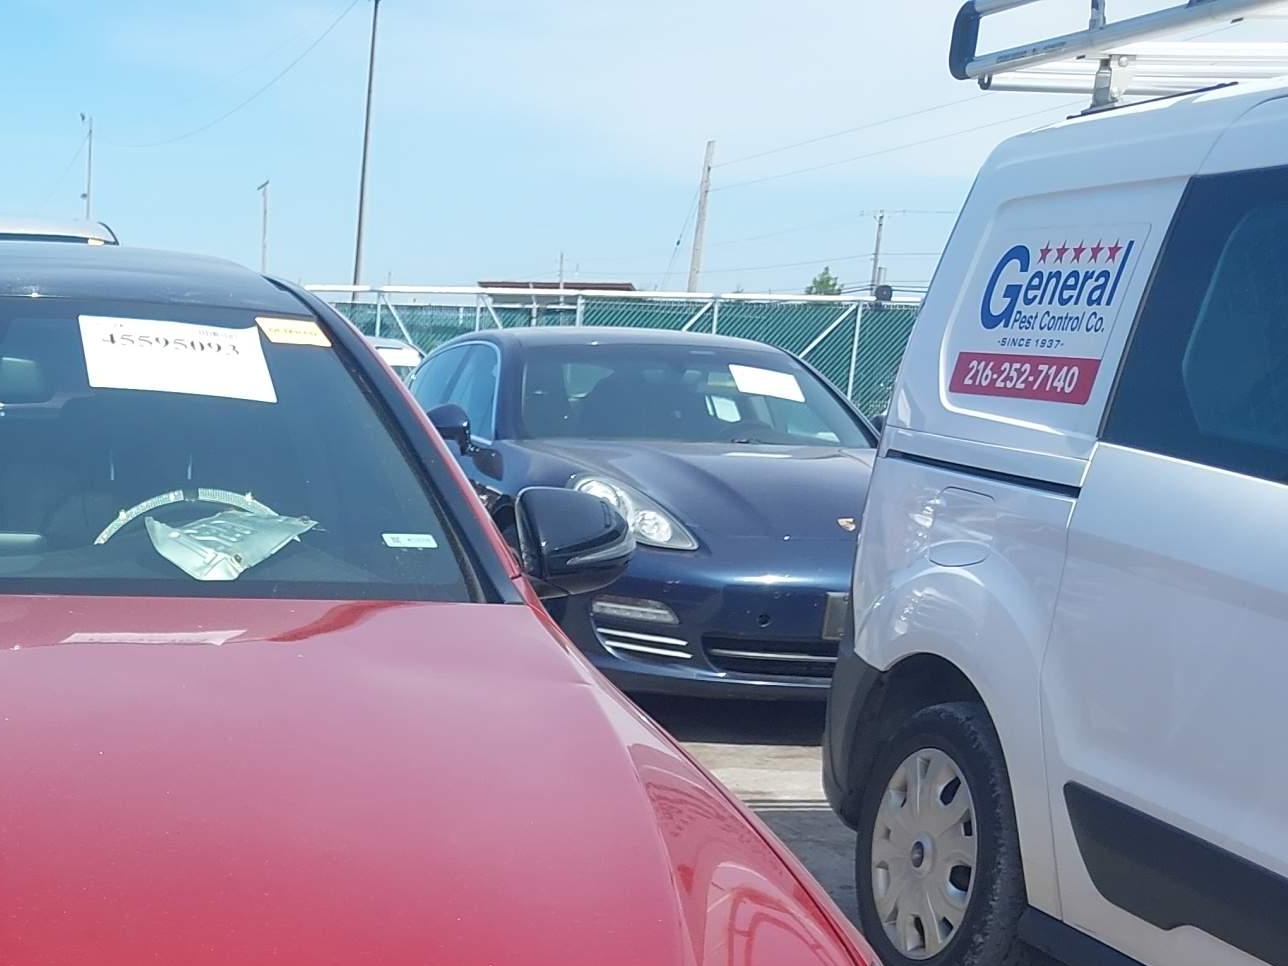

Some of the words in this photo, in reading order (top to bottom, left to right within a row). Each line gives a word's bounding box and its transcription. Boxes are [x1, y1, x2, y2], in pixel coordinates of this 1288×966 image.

[981, 240, 1135, 330] General
[1011, 310, 1038, 330] Pest
[1039, 311, 1086, 331] Control
[1085, 311, 1105, 333] Co.
[964, 360, 1079, 394] 216-252-7140
